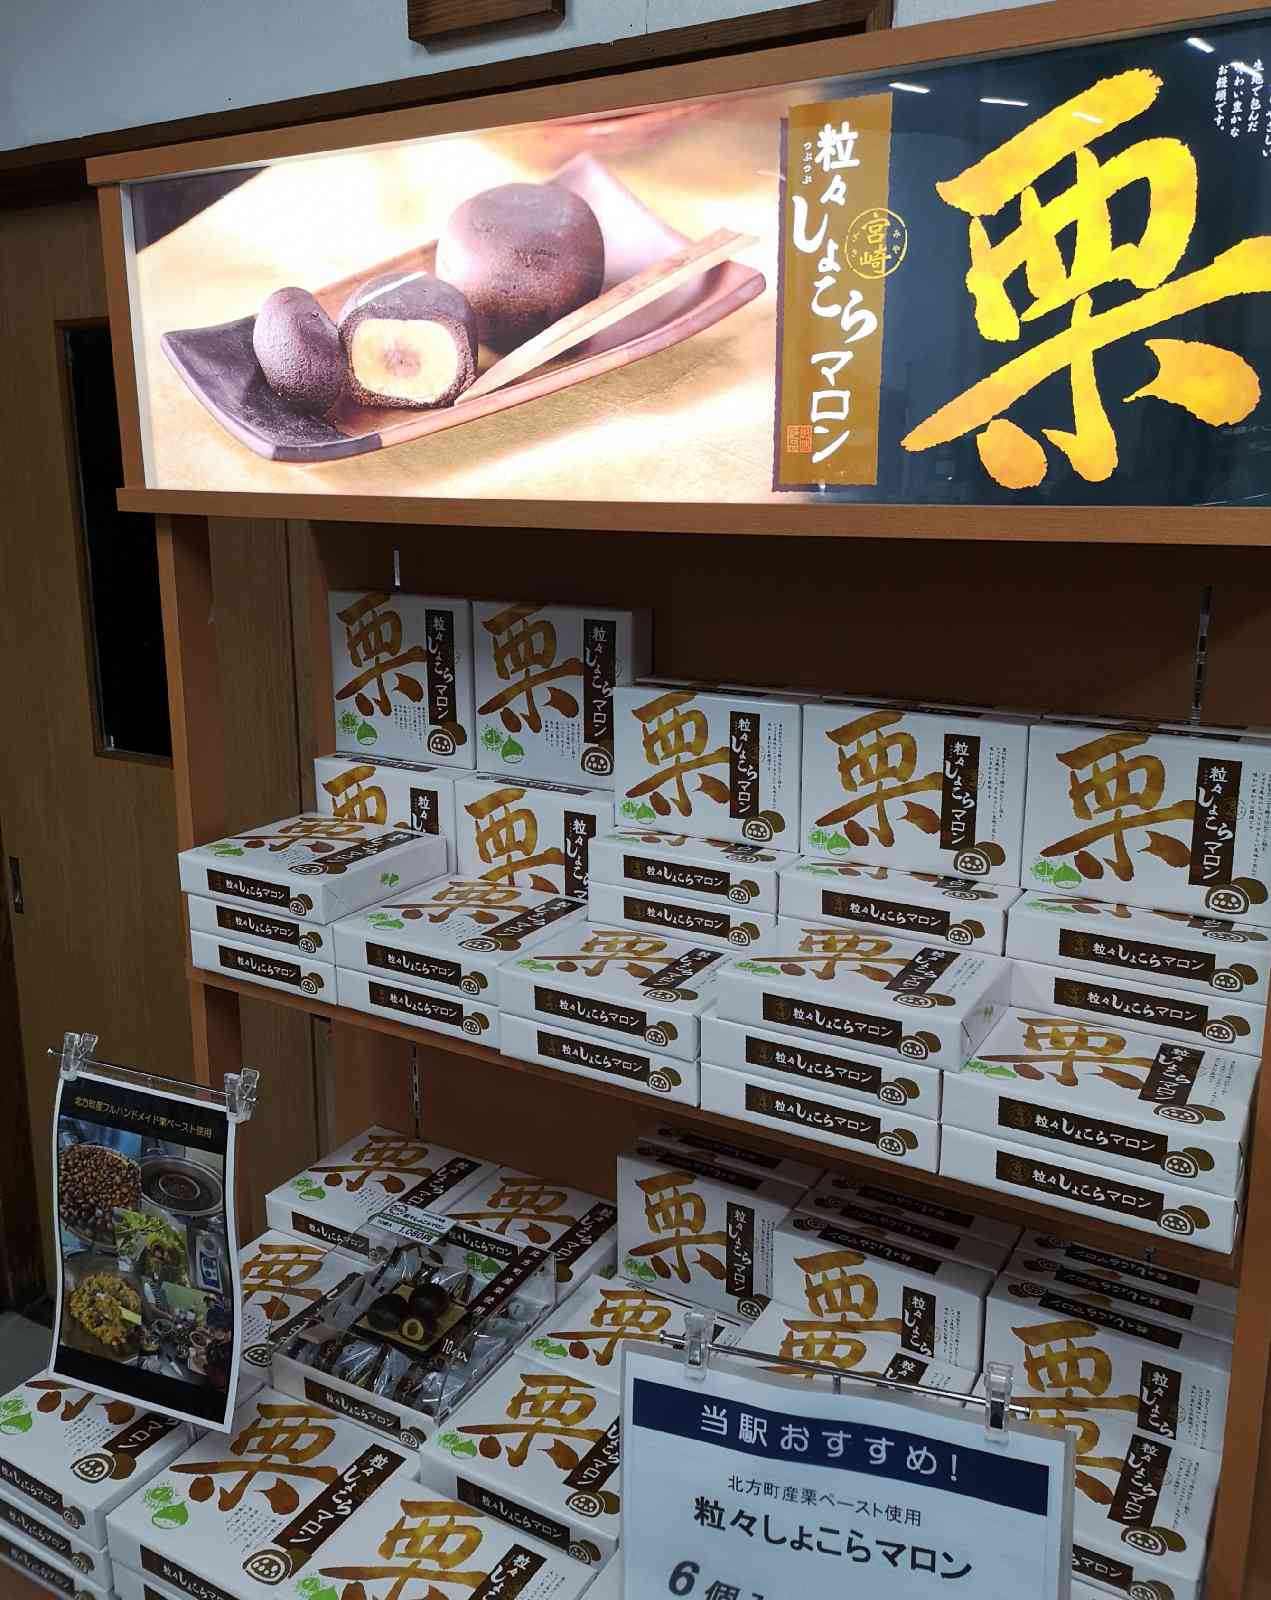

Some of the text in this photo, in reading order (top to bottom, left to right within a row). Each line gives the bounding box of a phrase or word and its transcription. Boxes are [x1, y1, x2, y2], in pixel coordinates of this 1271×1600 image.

[859, 211, 893, 275] 宮崎
[901, 68, 1271, 489] 栗
[792, 121, 877, 463] 粒々しょこらマロン
[336, 592, 427, 716] 栗
[477, 605, 584, 733] 栗
[625, 690, 730, 817] 栗
[731, 718, 758, 813] 粒々しょこらマロン
[814, 710, 944, 847] 栗
[945, 741, 975, 845] 粒々しょこらマロン
[1040, 732, 1196, 881] 栗
[1198, 766, 1233, 880] 粒々しょこらマロン
[1092, 942, 1205, 971] 粒々しょこらマロン
[792, 1006, 893, 1036] 粒々しょこらマロン
[1087, 992, 1199, 1022] 粒々しょこらマロン
[775, 1050, 872, 1082] 粒々しょこらマロン
[774, 1099, 871, 1132] 粒々しょこらマロン
[1034, 1114, 1155, 1151] 粒々しょこらマロン
[629, 1171, 728, 1283] 栗
[1032, 1168, 1152, 1208] 粒々しょこらマロン
[169, 1402, 338, 1513] 栗
[700, 1403, 958, 1482] 当駅おすすめ!
[289, 1454, 390, 1544] 粒々しょこらマロン
[694, 1496, 972, 1581] 粒々しょこらマロン
[728, 1474, 922, 1528] 北方町産栗ペースト使用
